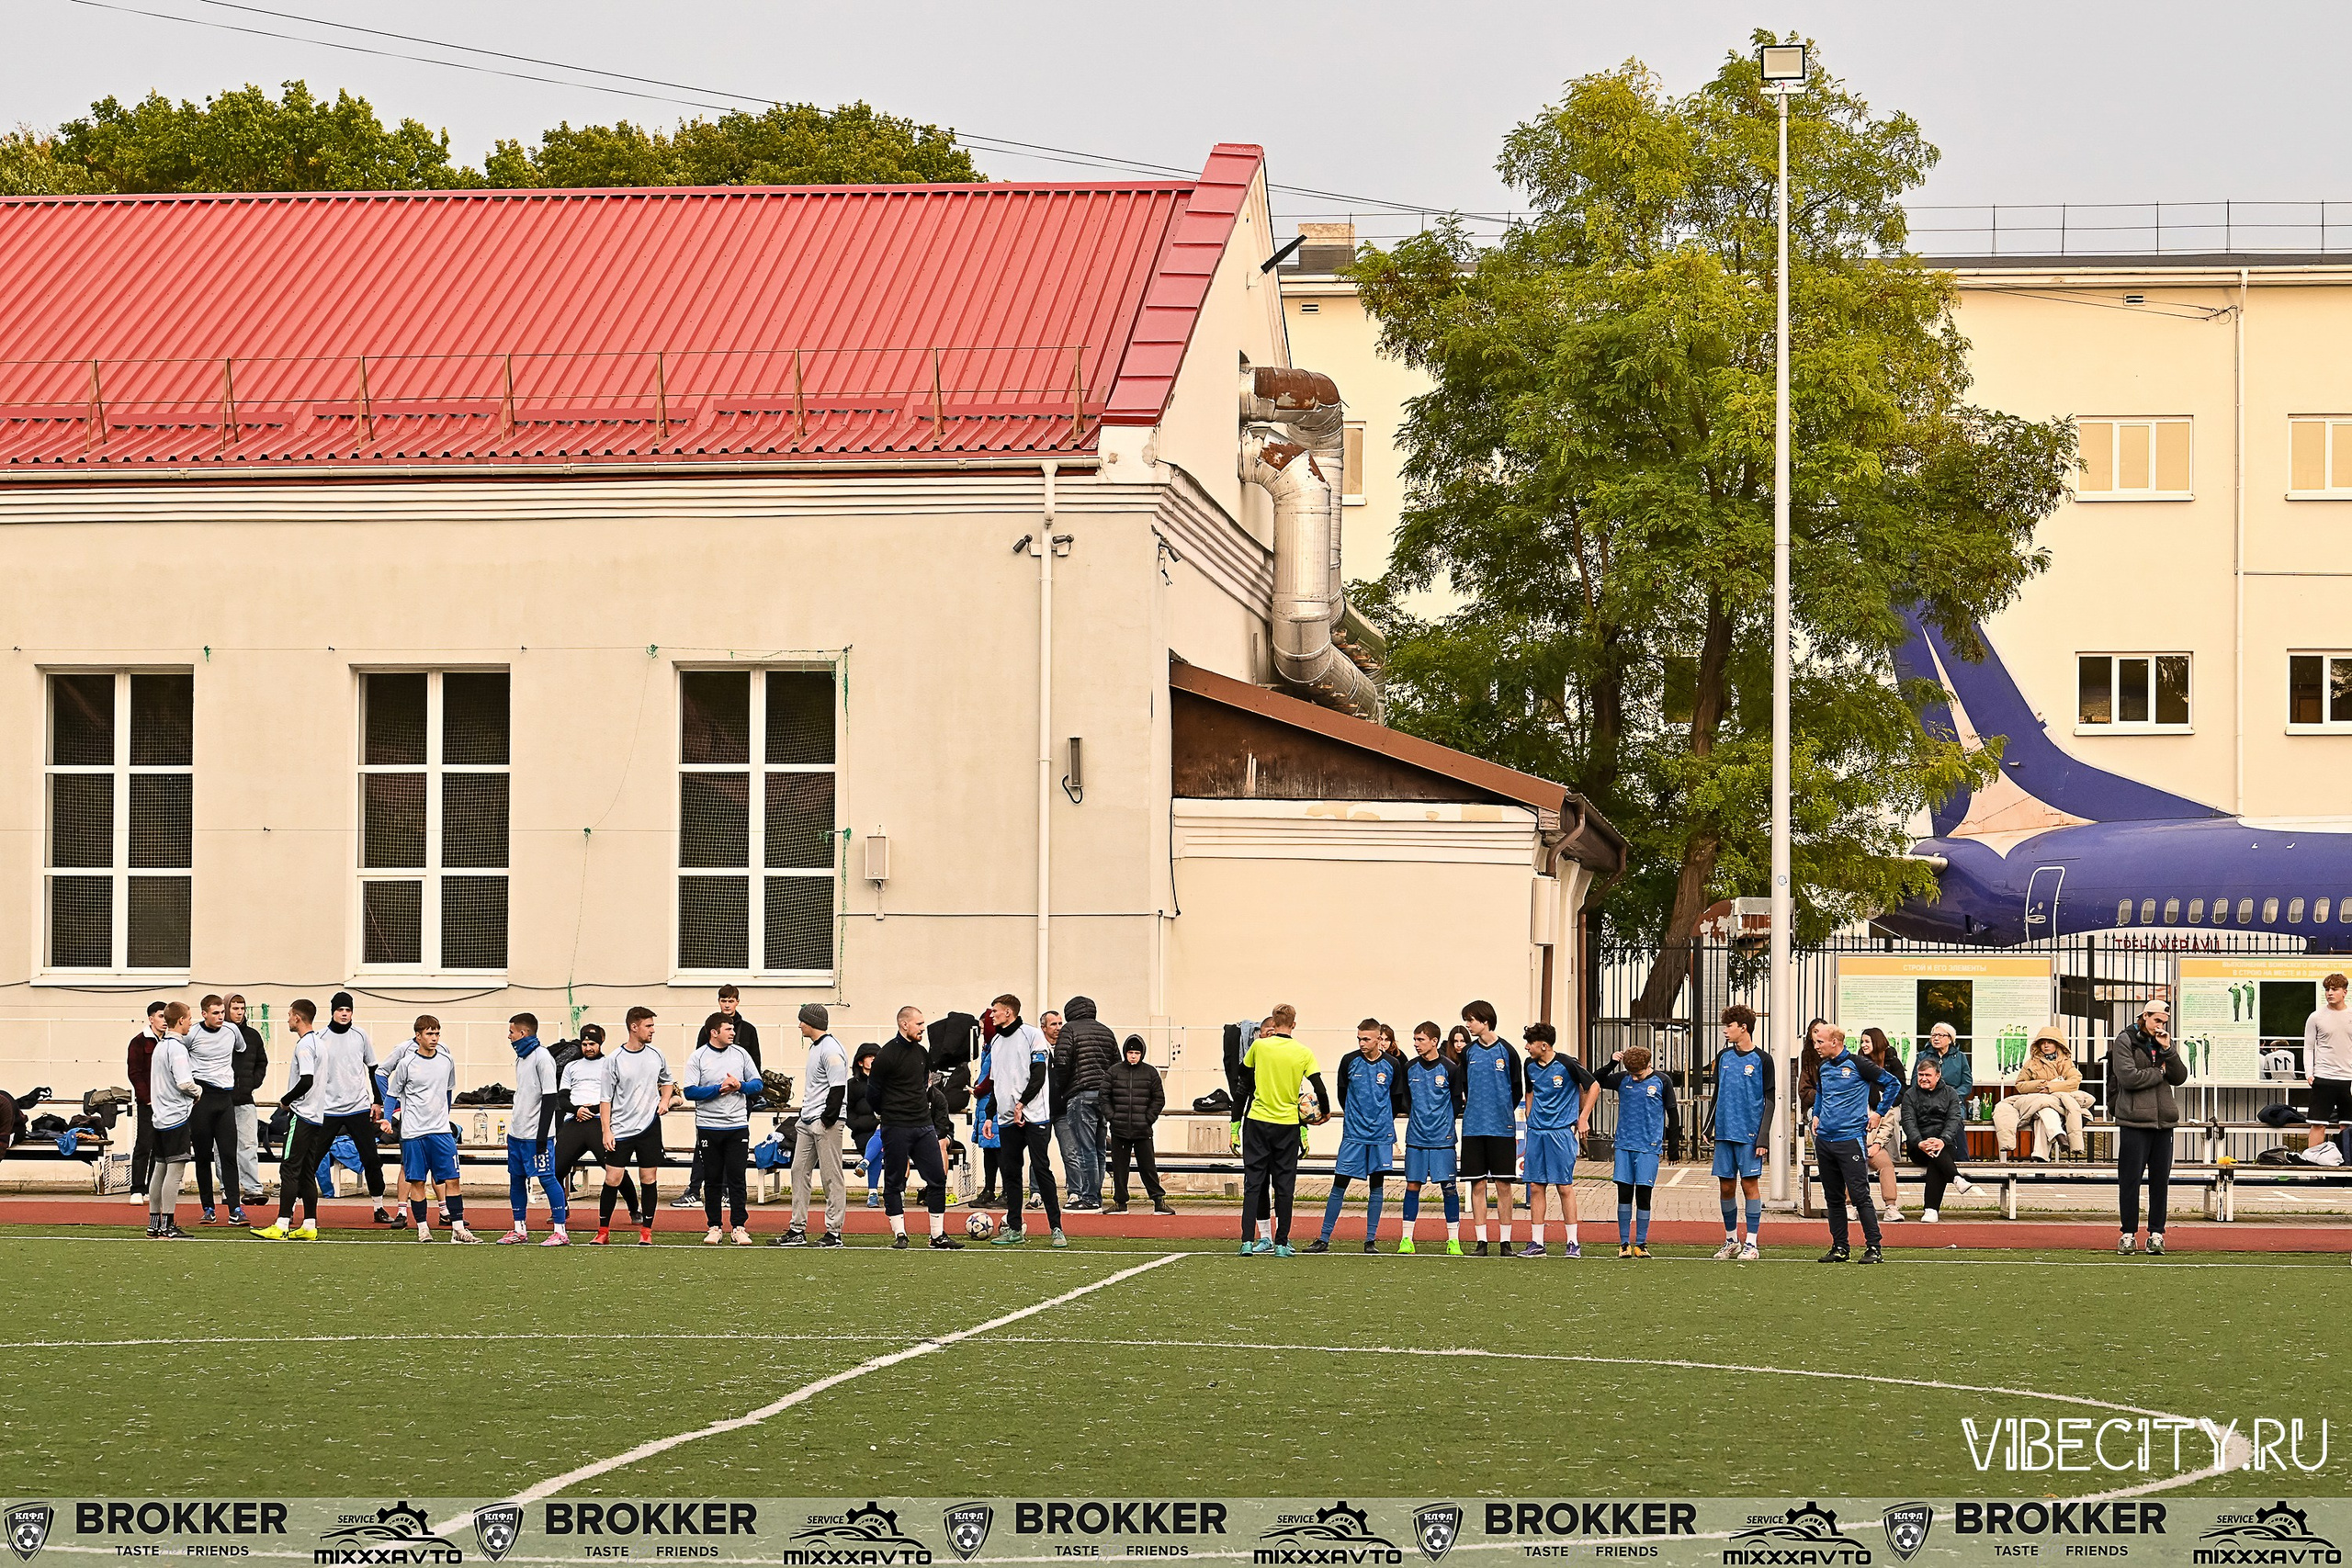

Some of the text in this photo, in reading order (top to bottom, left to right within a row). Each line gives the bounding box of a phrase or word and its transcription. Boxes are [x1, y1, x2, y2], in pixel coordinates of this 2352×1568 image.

[1903, 963, 1926, 971] СТРОЙ
[701, 1139, 709, 1147] 22
[533, 1155, 547, 1169] 13
